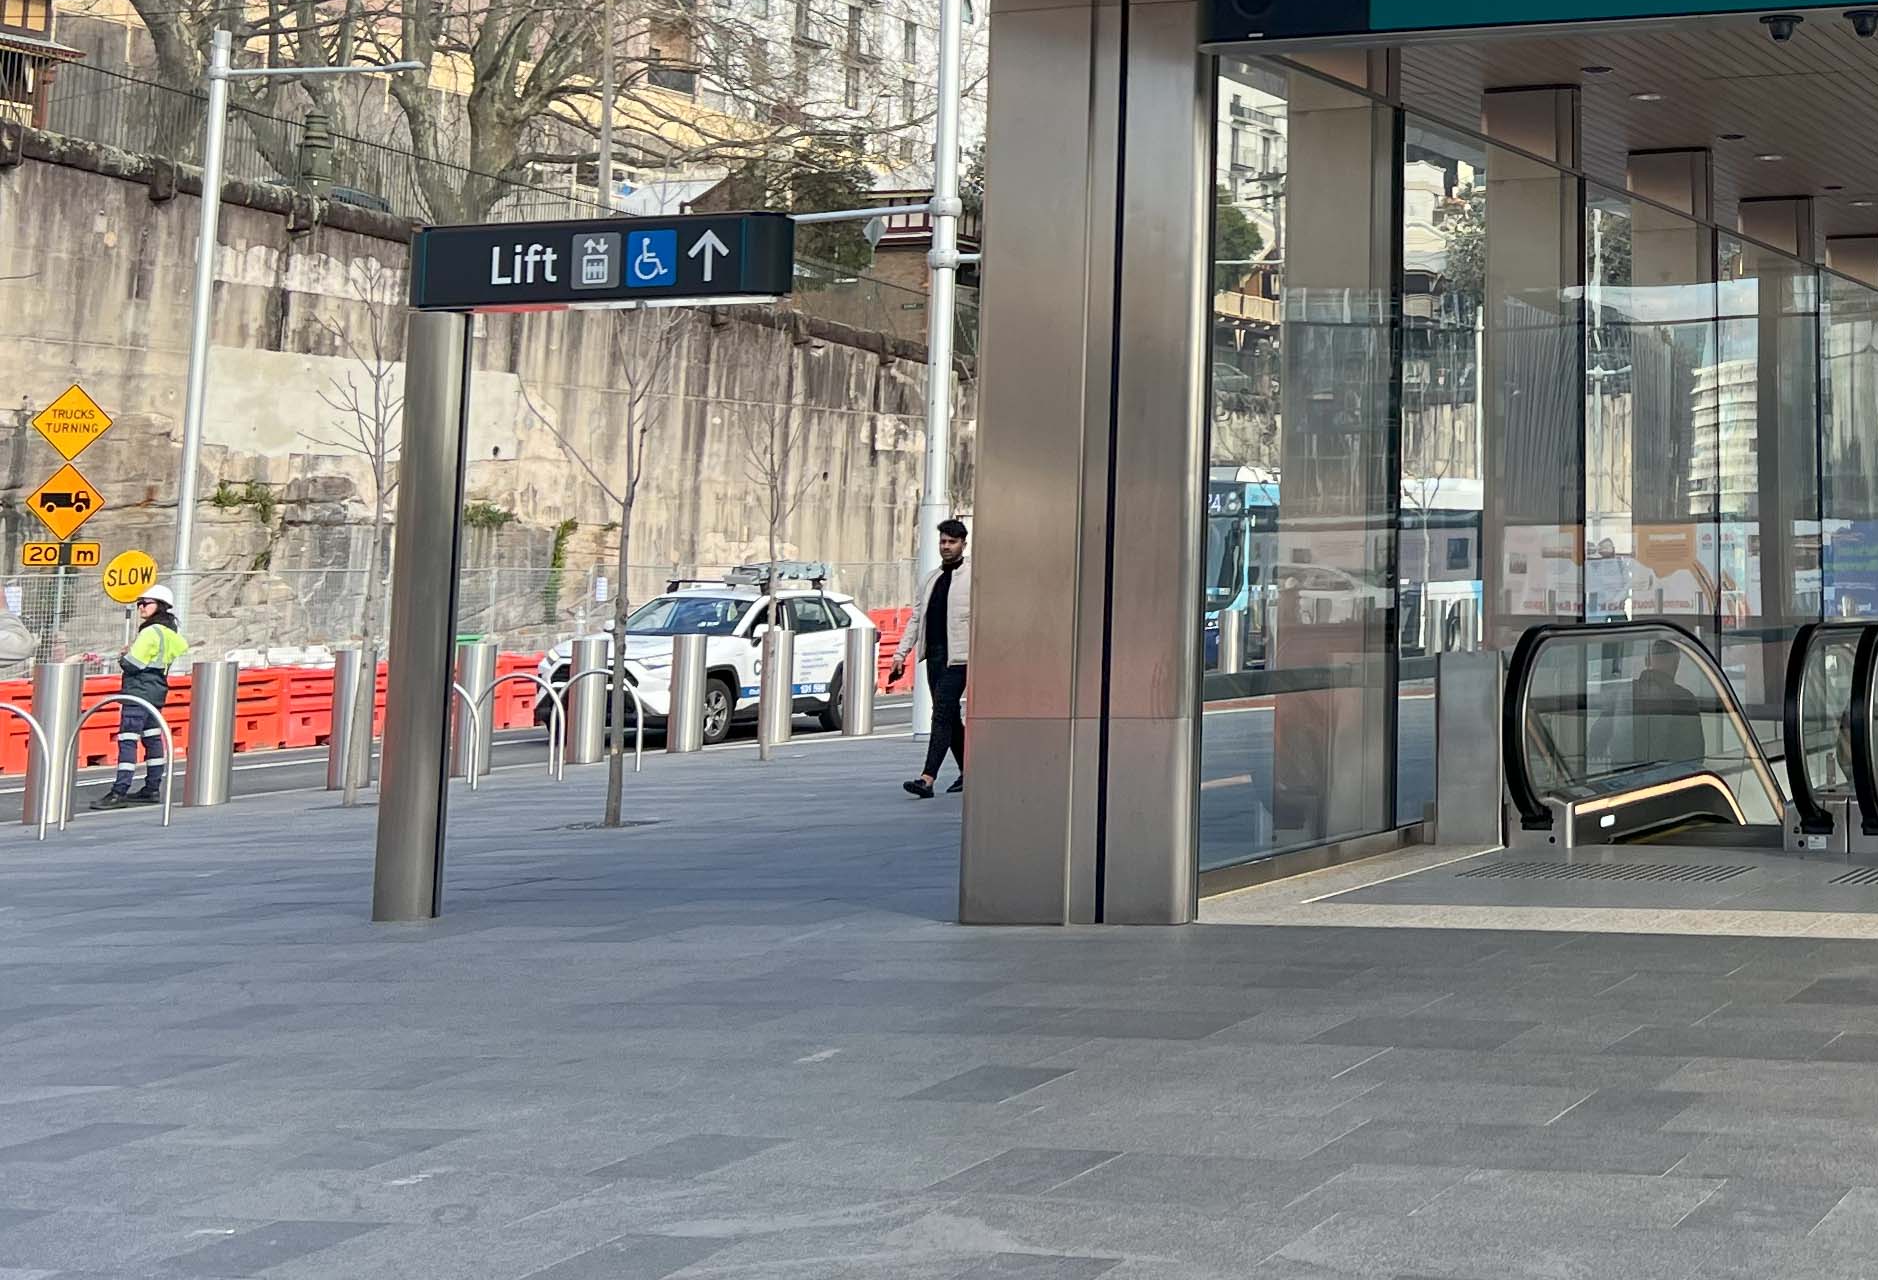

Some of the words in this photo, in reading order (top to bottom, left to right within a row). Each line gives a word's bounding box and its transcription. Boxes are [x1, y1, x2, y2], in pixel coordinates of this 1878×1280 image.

[491, 244, 557, 285] Lift
[51, 409, 95, 420] TRUCKS
[46, 423, 99, 434] TURNING
[29, 547, 57, 562] 20
[76, 550, 94, 562] m
[107, 566, 153, 587] SLOW
